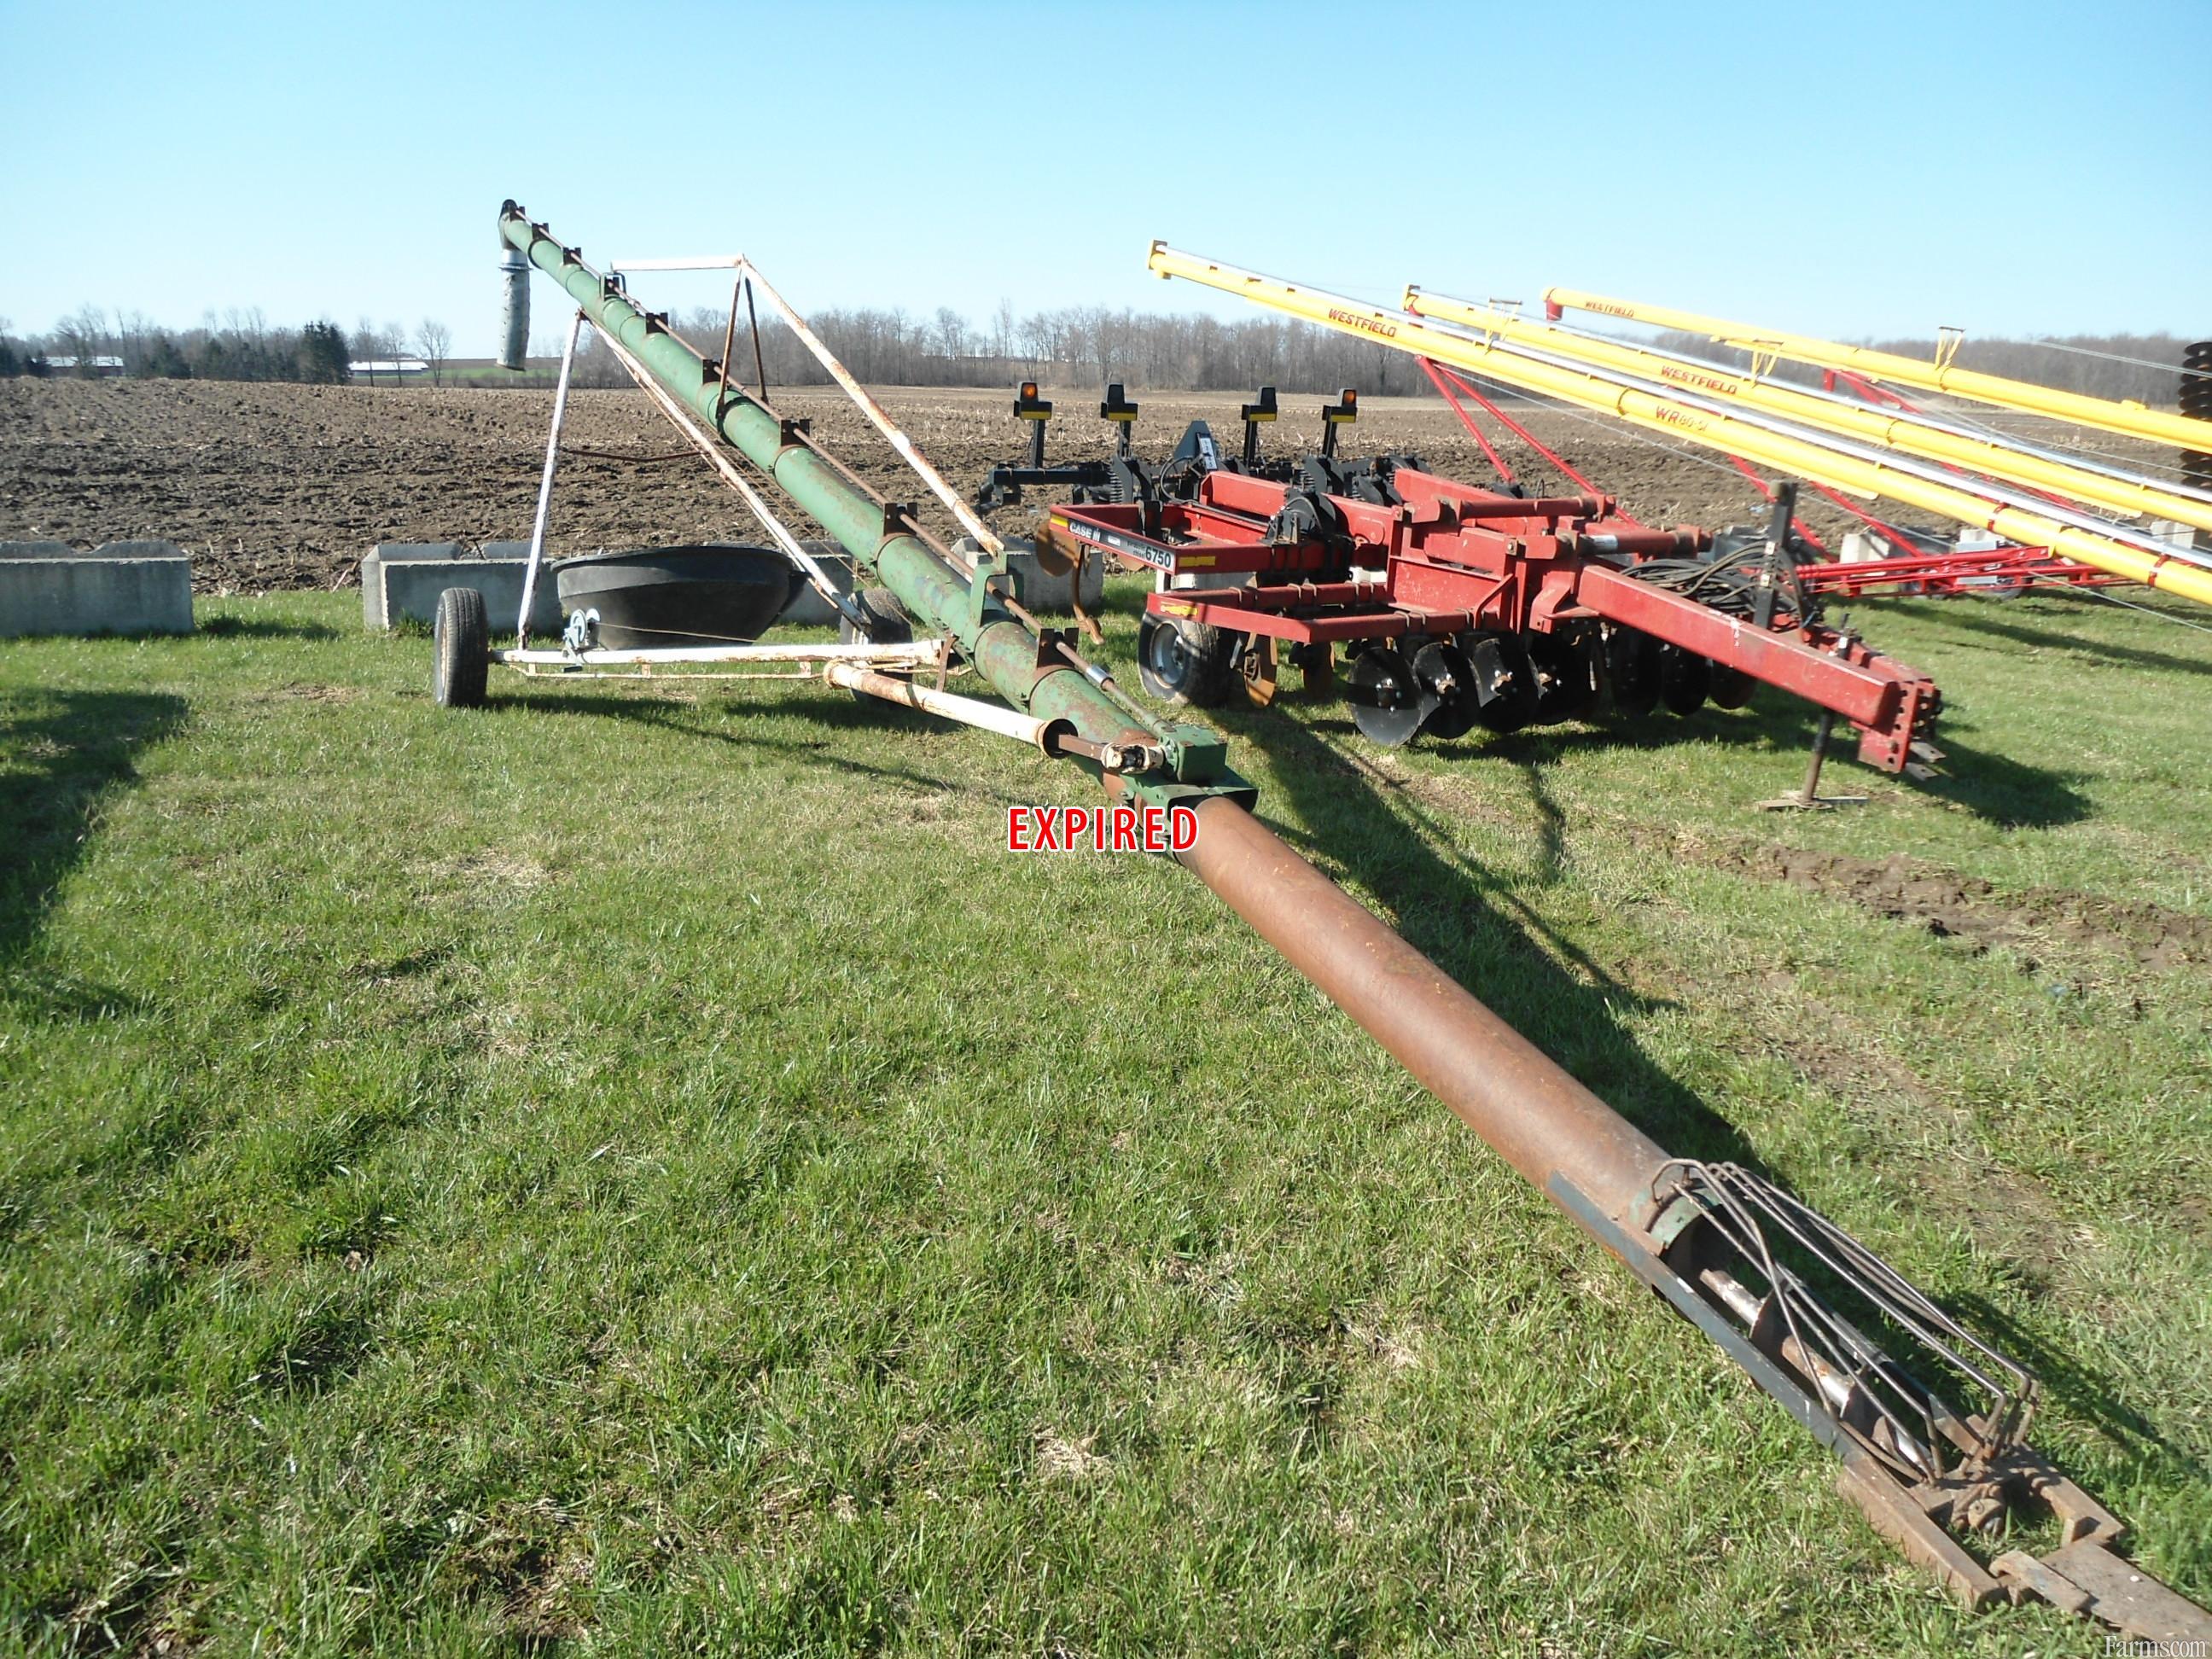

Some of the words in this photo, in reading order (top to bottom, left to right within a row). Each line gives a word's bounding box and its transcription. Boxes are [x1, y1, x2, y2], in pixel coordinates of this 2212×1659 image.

[1329, 308, 1397, 338] WESTFIELD
[1661, 365, 1738, 394] WESTFIELD
[1069, 521, 1091, 538] CASE
[1145, 546, 1172, 568] 6750
